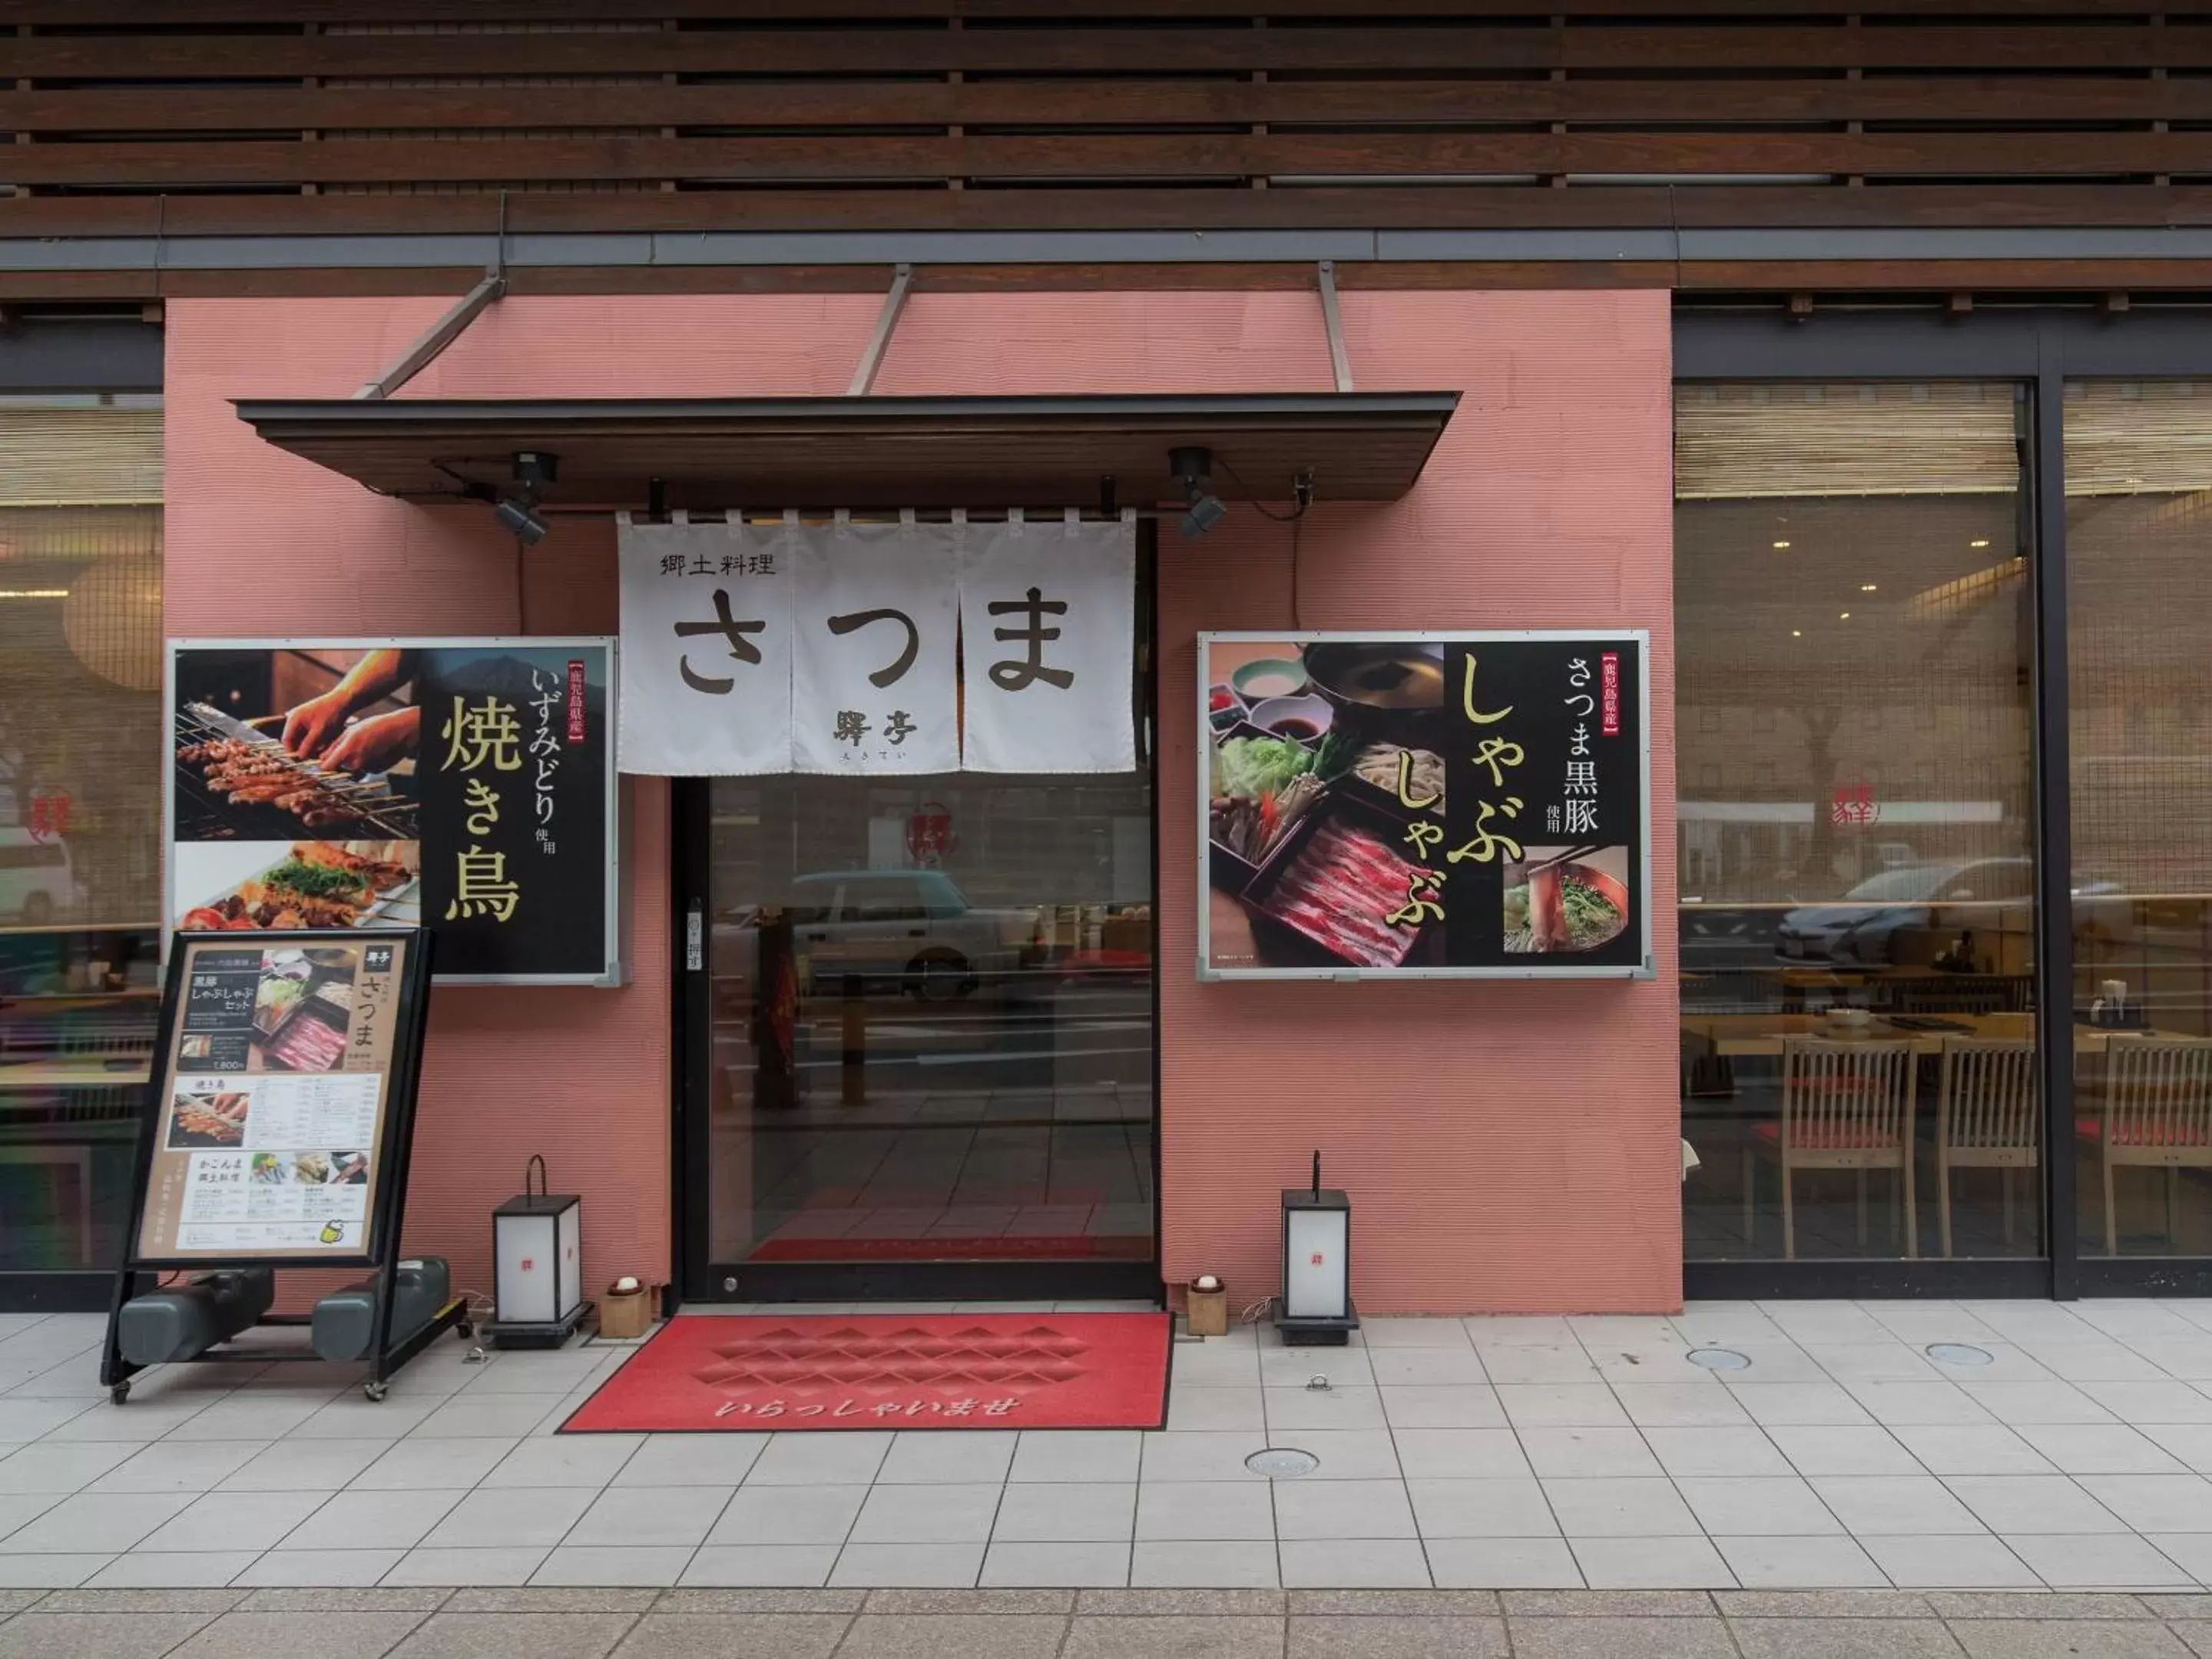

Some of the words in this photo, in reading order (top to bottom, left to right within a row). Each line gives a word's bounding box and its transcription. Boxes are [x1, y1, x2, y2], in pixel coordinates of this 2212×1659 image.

[661, 554, 776, 577] 郷土料理
[674, 587, 1075, 695] さつま
[528, 668, 562, 823] いずみどり
[1447, 652, 1525, 863] しゃぶ
[1564, 657, 1600, 834] さつま黒豚
[440, 696, 522, 922] 焼き鳥
[535, 829, 556, 855] 使用
[1386, 750, 1447, 926] しゃぶ
[1545, 805, 1561, 833] 使用
[192, 988, 254, 999] しゃぶしゃぶ
[355, 977, 381, 1046] さつま
[715, 1398, 1021, 1418] いらっしゃいませ
